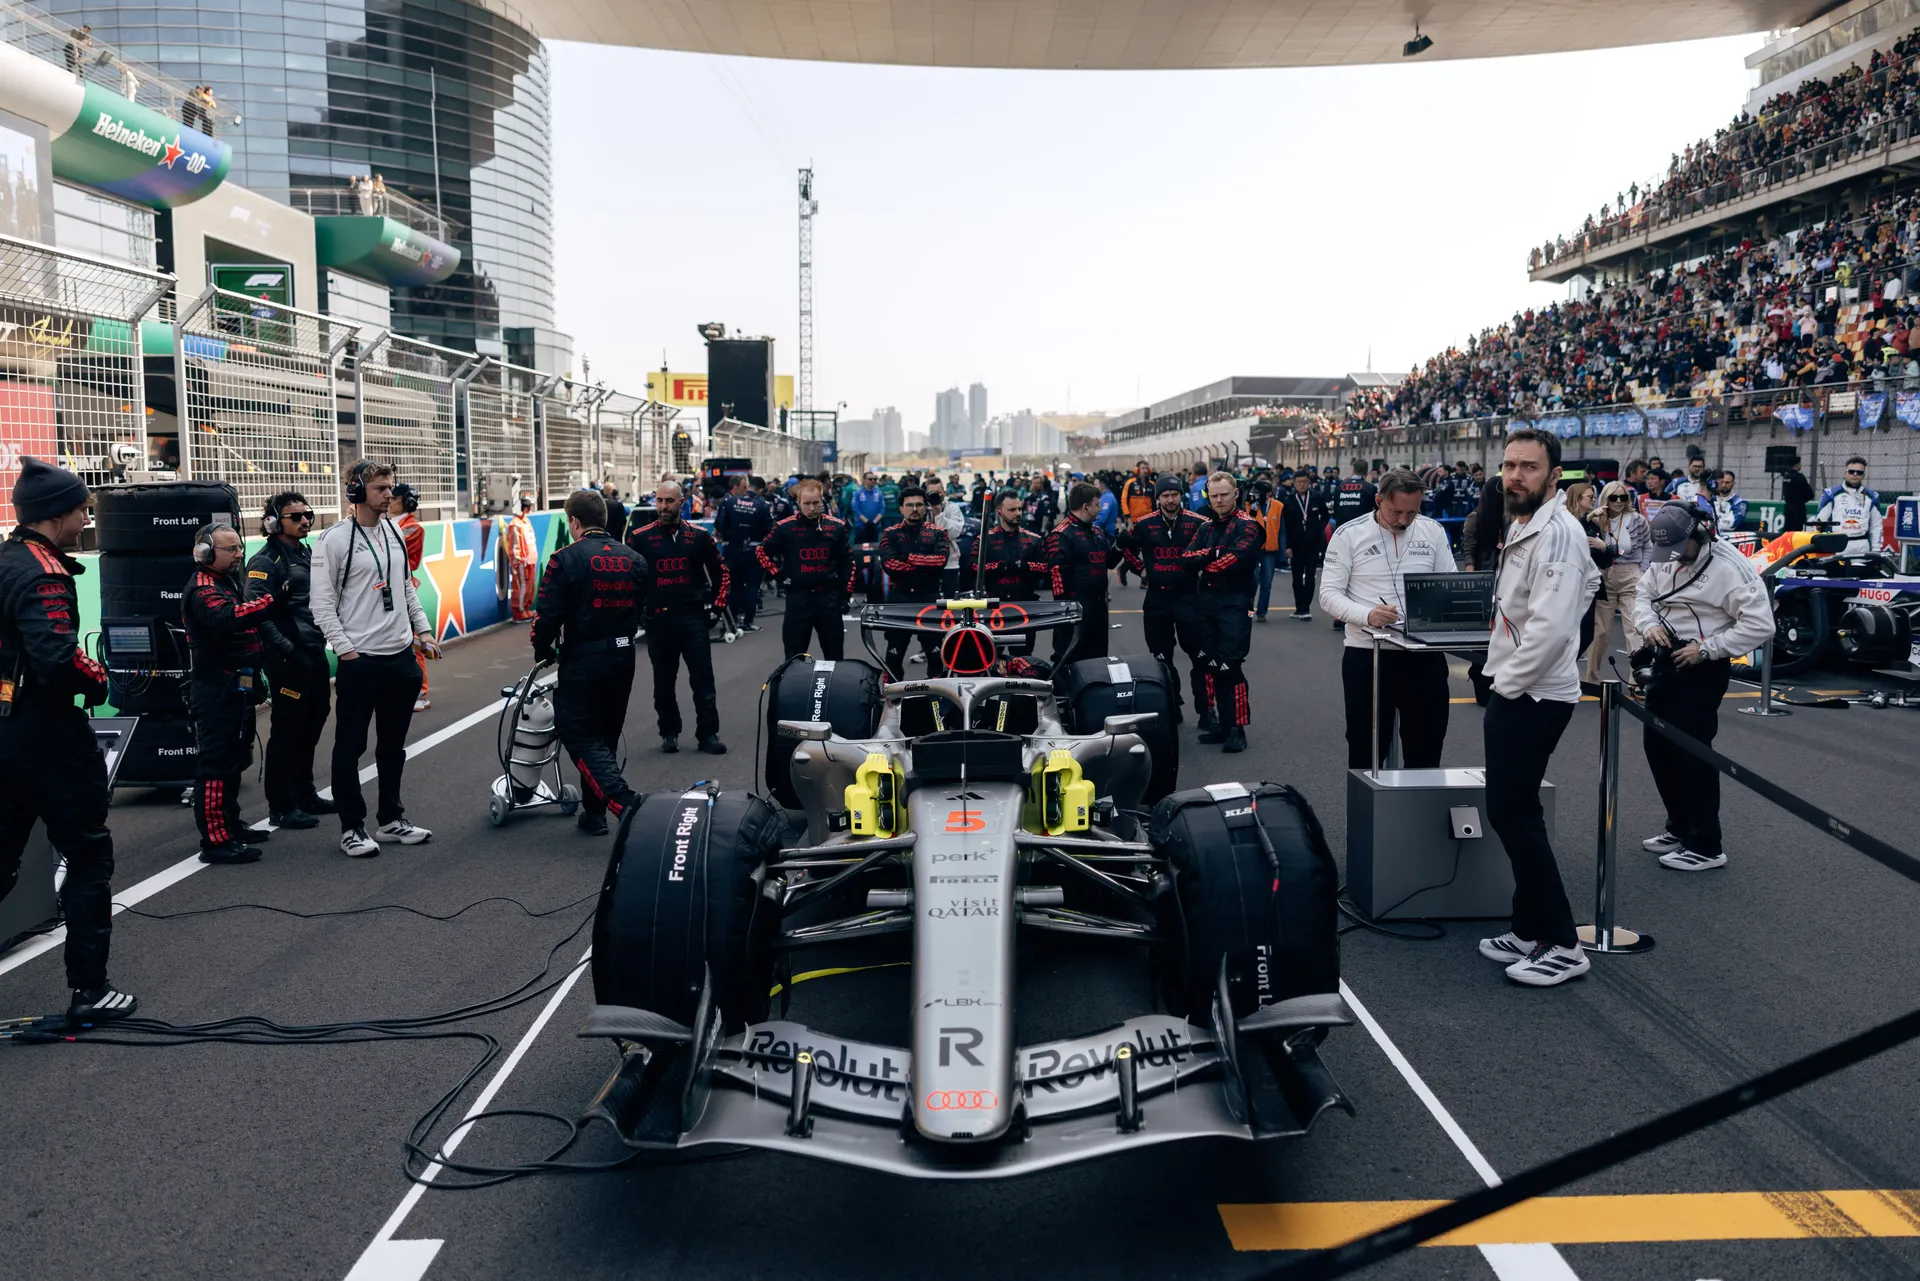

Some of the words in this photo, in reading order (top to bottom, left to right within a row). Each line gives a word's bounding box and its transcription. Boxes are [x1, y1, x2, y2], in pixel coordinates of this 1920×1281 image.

[92, 112, 162, 157] Heineken
[153, 517, 179, 525] Front
[593, 579, 633, 591] Revolut
[161, 591, 183, 599] Rear
[1859, 588, 1891, 602] HUGO
[615, 637, 630, 647] OMP
[814, 677, 826, 698] Right
[904, 684, 930, 692] Gillette
[957, 682, 977, 698] R
[1005, 681, 1031, 689] Gillette
[811, 700, 822, 722] Rear
[159, 748, 183, 756] Front
[186, 747, 199, 756] Ri
[1224, 806, 1253, 817] KLS
[676, 807, 699, 836] Right
[945, 811, 986, 832] 5
[668, 839, 690, 881] Front
[930, 875, 999, 884] PIRELLI
[950, 897, 999, 907] visit
[928, 907, 999, 919] QATAR
[1257, 945, 1272, 991] Front
[939, 1027, 985, 1067] R
